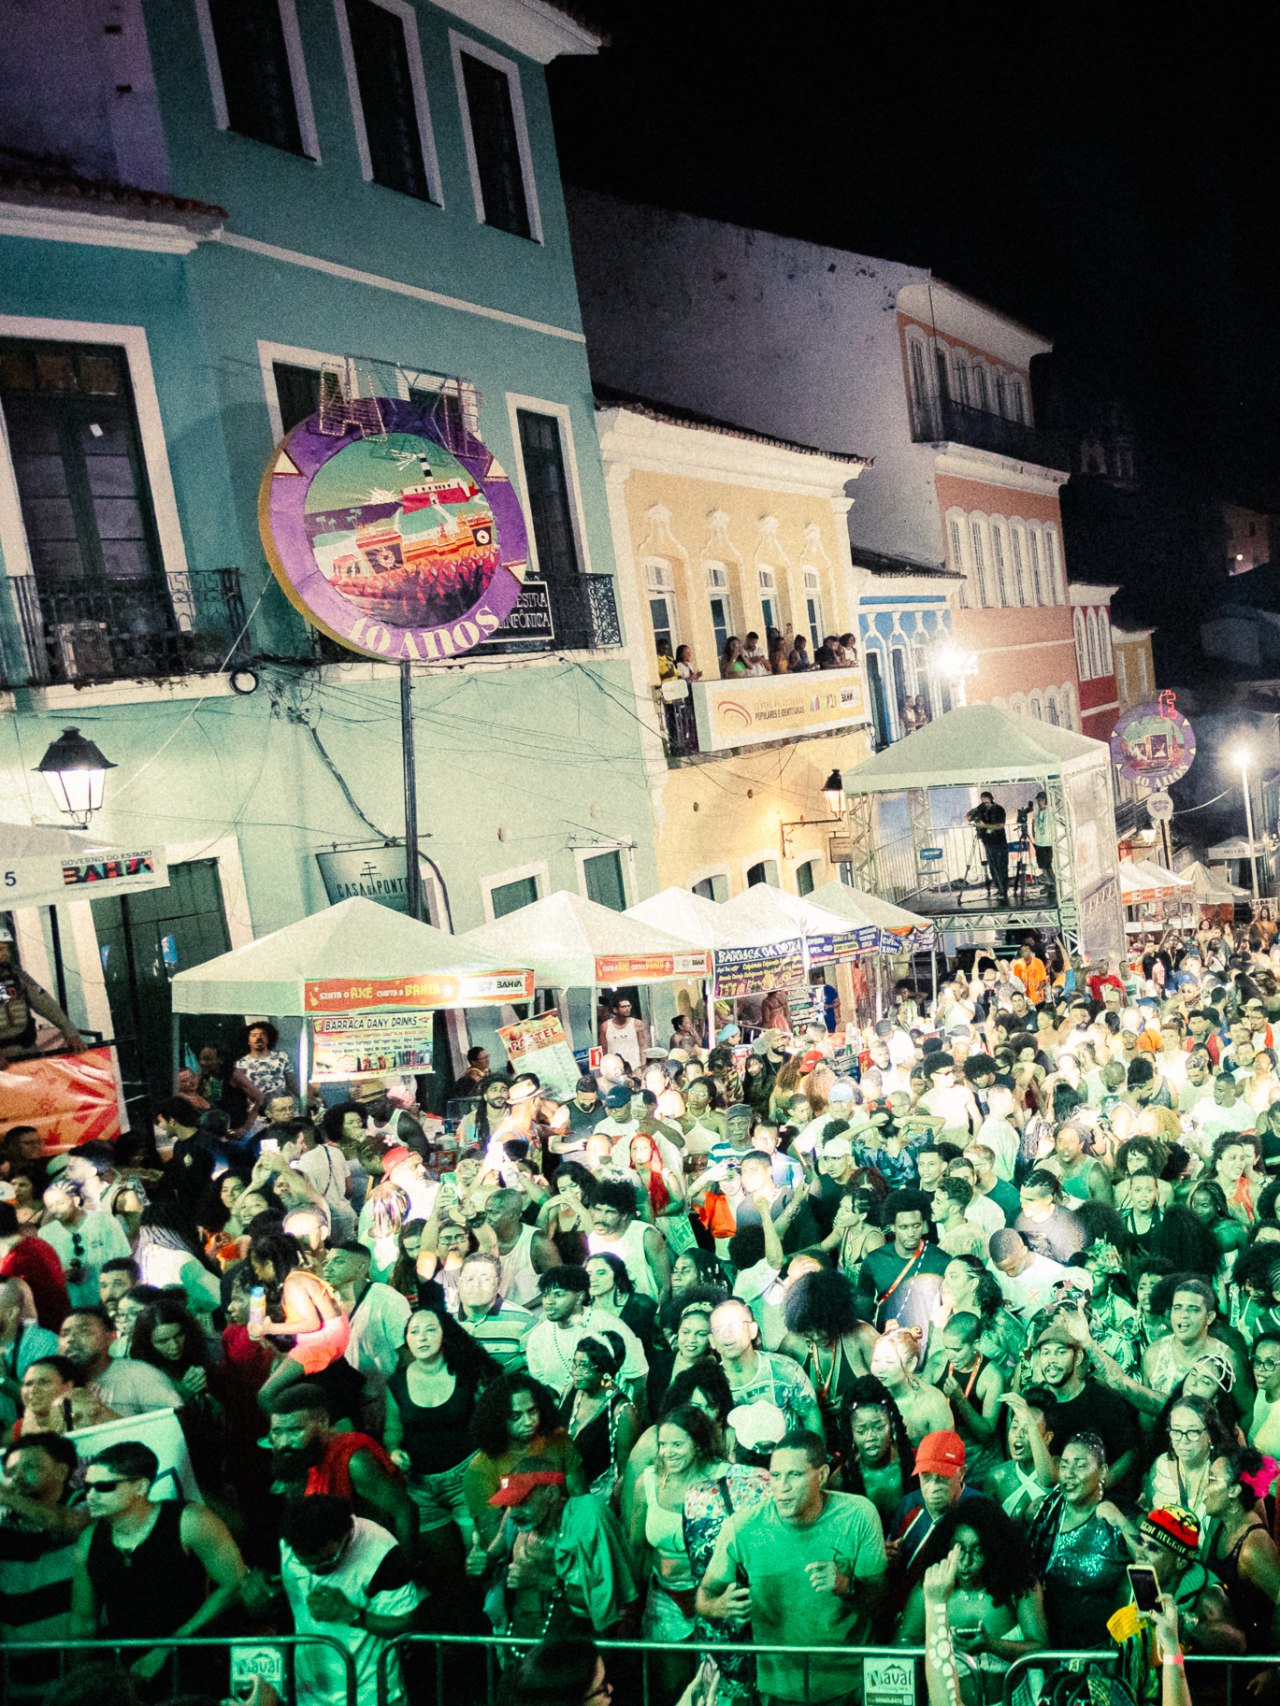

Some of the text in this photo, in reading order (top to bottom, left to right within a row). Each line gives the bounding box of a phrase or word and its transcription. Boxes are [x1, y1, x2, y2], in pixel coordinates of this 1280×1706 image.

[348, 617, 391, 651] 40
[61, 850, 153, 867] GOVERNO DO ESTADO
[4, 871, 17, 887] 5
[62, 856, 155, 885] BAHIA
[336, 881, 367, 898] CASA
[351, 984, 373, 999] AXÉ
[404, 983, 441, 997] BAHIA
[496, 980, 523, 989] BAHIA
[324, 1016, 418, 1031] BARRACA DANY DRINKS
[867, 1669, 912, 1687] Naval
